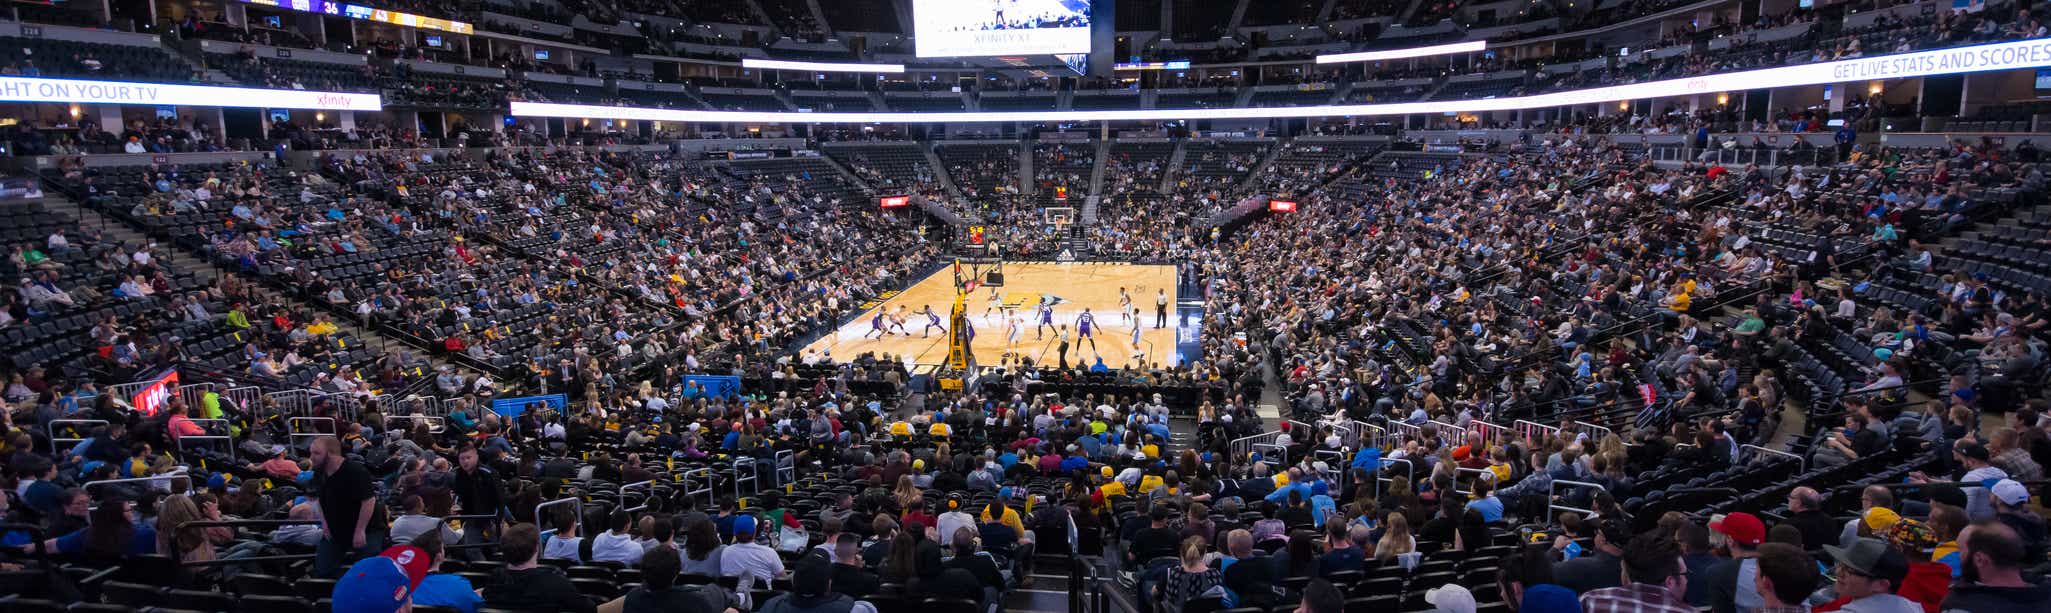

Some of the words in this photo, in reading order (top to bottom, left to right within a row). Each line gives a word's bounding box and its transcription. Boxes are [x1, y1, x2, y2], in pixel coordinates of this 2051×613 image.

[324, 2, 338, 14] 36
[974, 34, 1016, 44] XFINITY
[1834, 64, 1858, 79] GET
[1861, 60, 1888, 76] LIVE
[1892, 55, 1934, 74] STATS
[1938, 51, 1975, 70] AND
[1979, 43, 2051, 67] SCORES
[0, 81, 31, 97] HT
[39, 82, 70, 98] ON
[75, 84, 130, 100] YOUR
[136, 86, 157, 100] TV
[317, 94, 351, 108] xfinity
